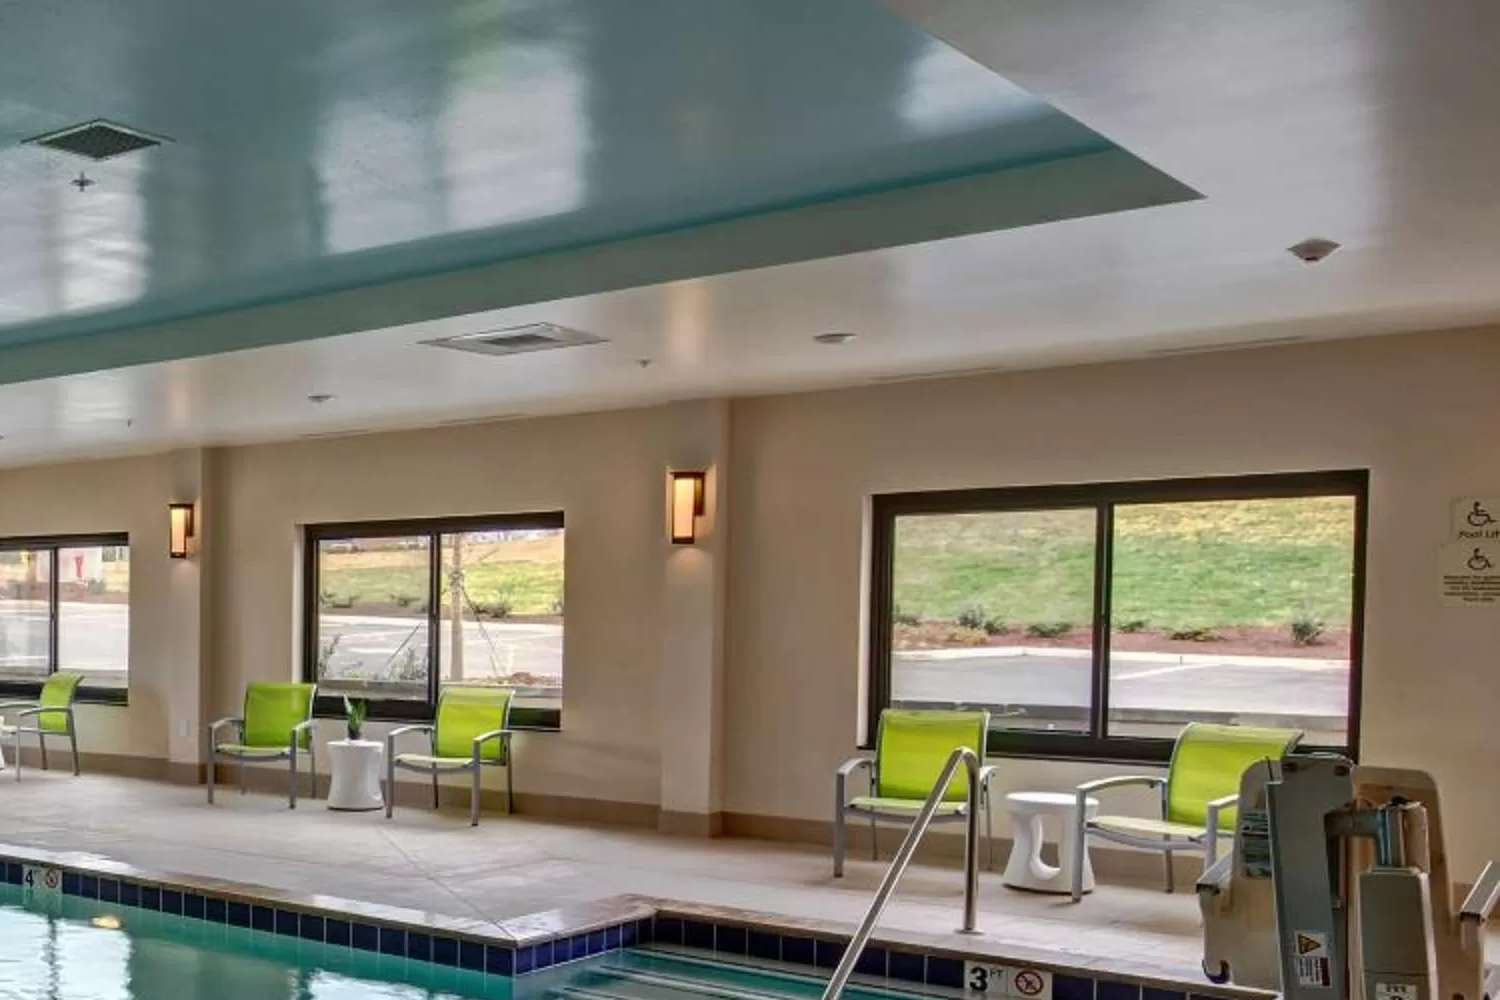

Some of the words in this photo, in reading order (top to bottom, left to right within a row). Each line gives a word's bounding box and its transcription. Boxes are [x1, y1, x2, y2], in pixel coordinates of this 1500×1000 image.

[25, 869, 34, 888] 4
[969, 965, 989, 991] 3
[990, 967, 1005, 978] FT
